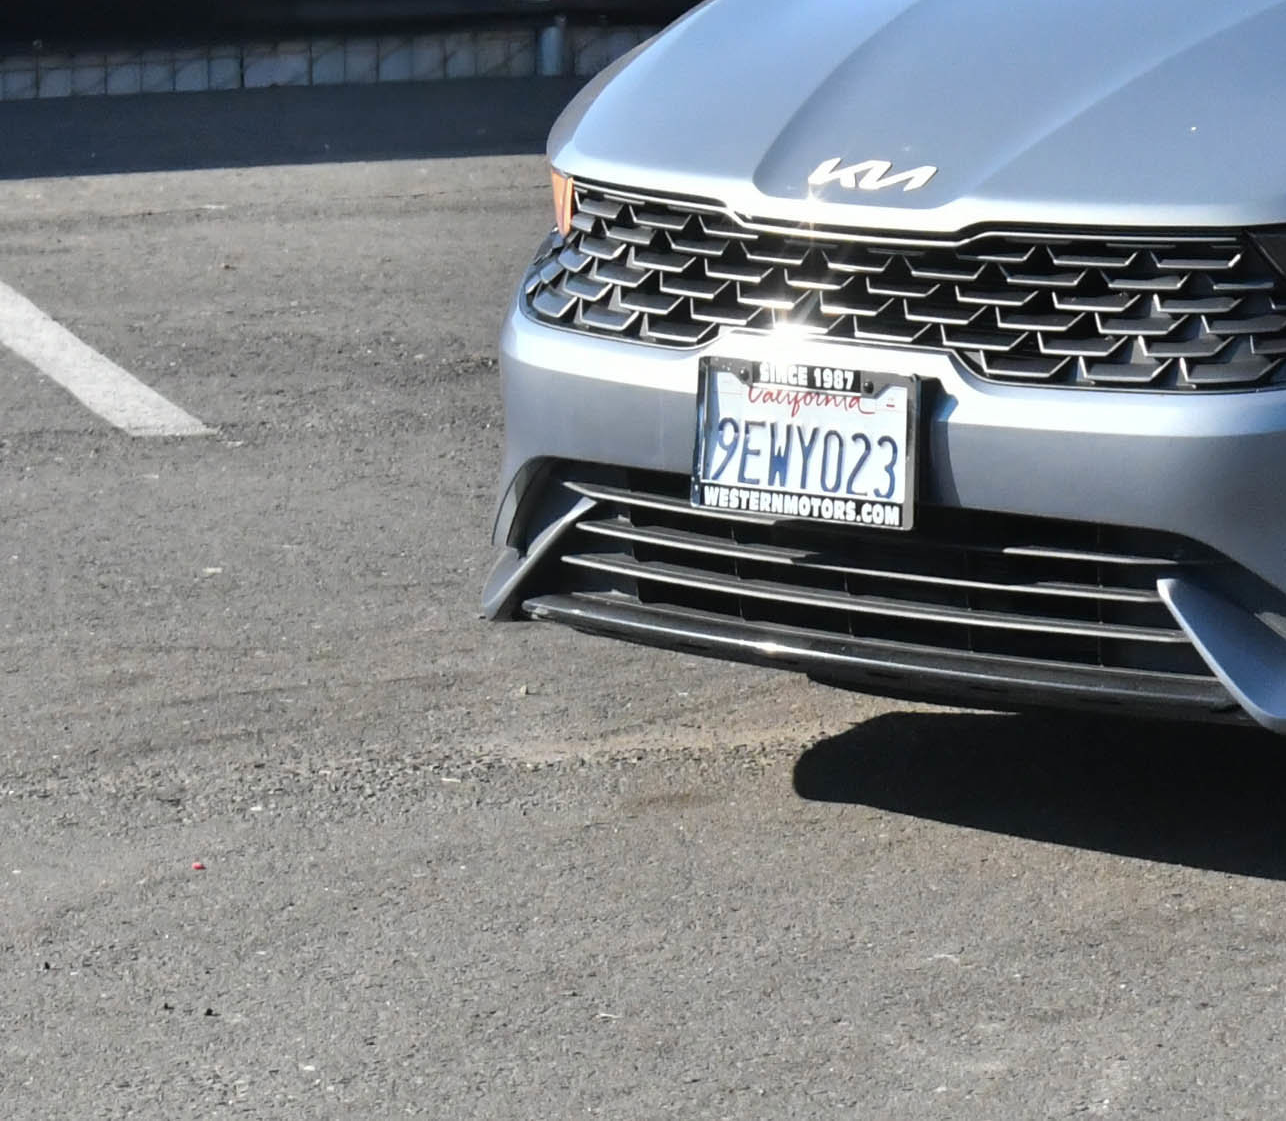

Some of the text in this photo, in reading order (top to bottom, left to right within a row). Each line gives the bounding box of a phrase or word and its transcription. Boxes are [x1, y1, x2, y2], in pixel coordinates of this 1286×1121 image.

[760, 362, 855, 390] SINCE 1987
[748, 388, 876, 418] California
[710, 417, 899, 500] 9EWY023
[703, 485, 900, 527] WESTERNMOTORS.COM
